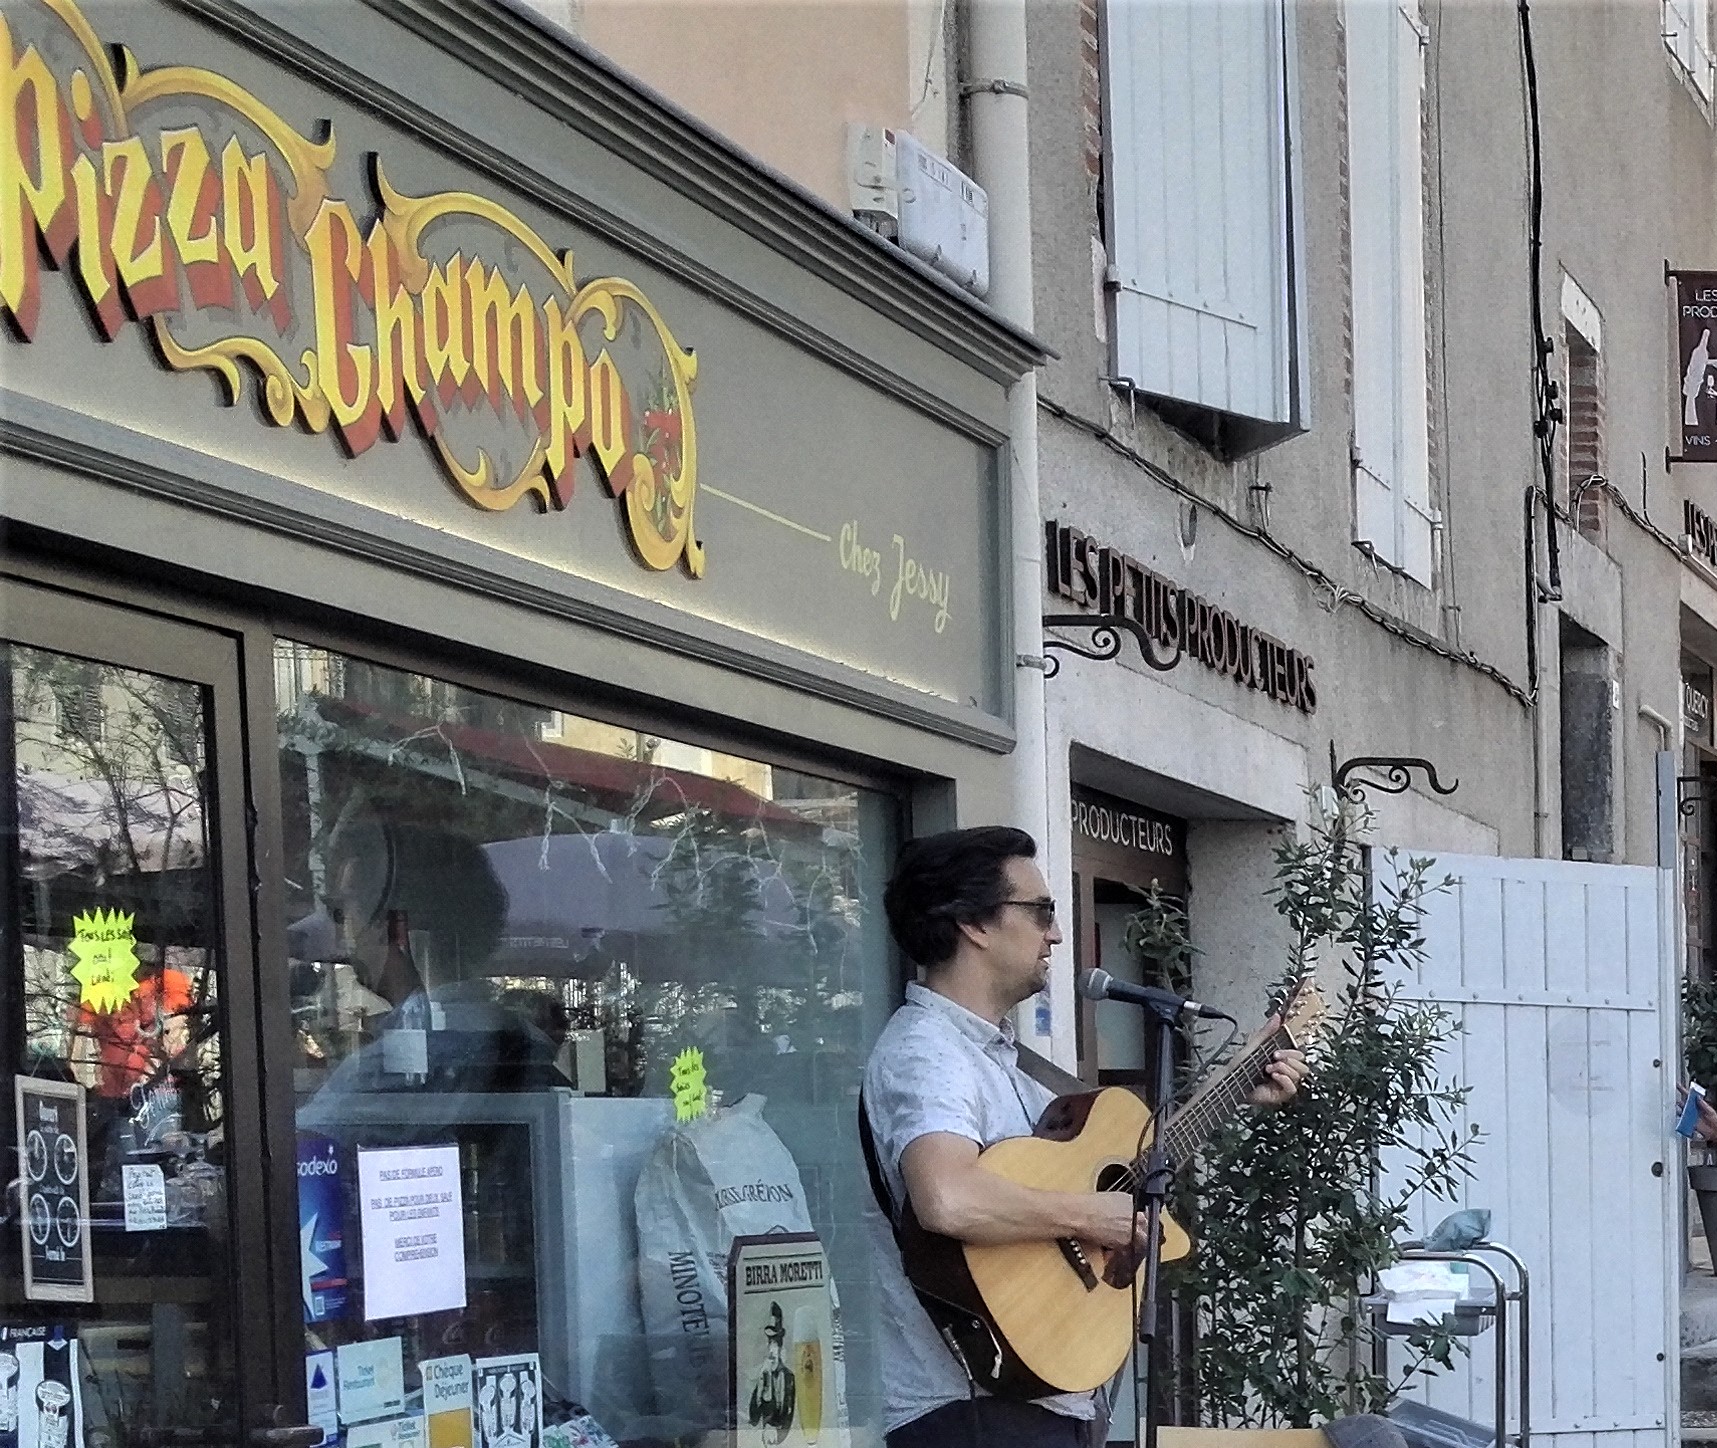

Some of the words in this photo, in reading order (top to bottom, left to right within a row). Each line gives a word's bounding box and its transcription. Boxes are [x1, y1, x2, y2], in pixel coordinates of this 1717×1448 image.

[1684, 435, 1711, 446] VINS
[840, 520, 880, 596] Chez
[889, 533, 953, 634] Jessy
[1045, 520, 1101, 609] LES
[1178, 588, 1318, 716] PRODUCTEURS
[1070, 799, 1173, 857] PRODUCTEURS
[746, 1264, 777, 1286] BIRRA
[780, 1261, 823, 1283] MORETTI
